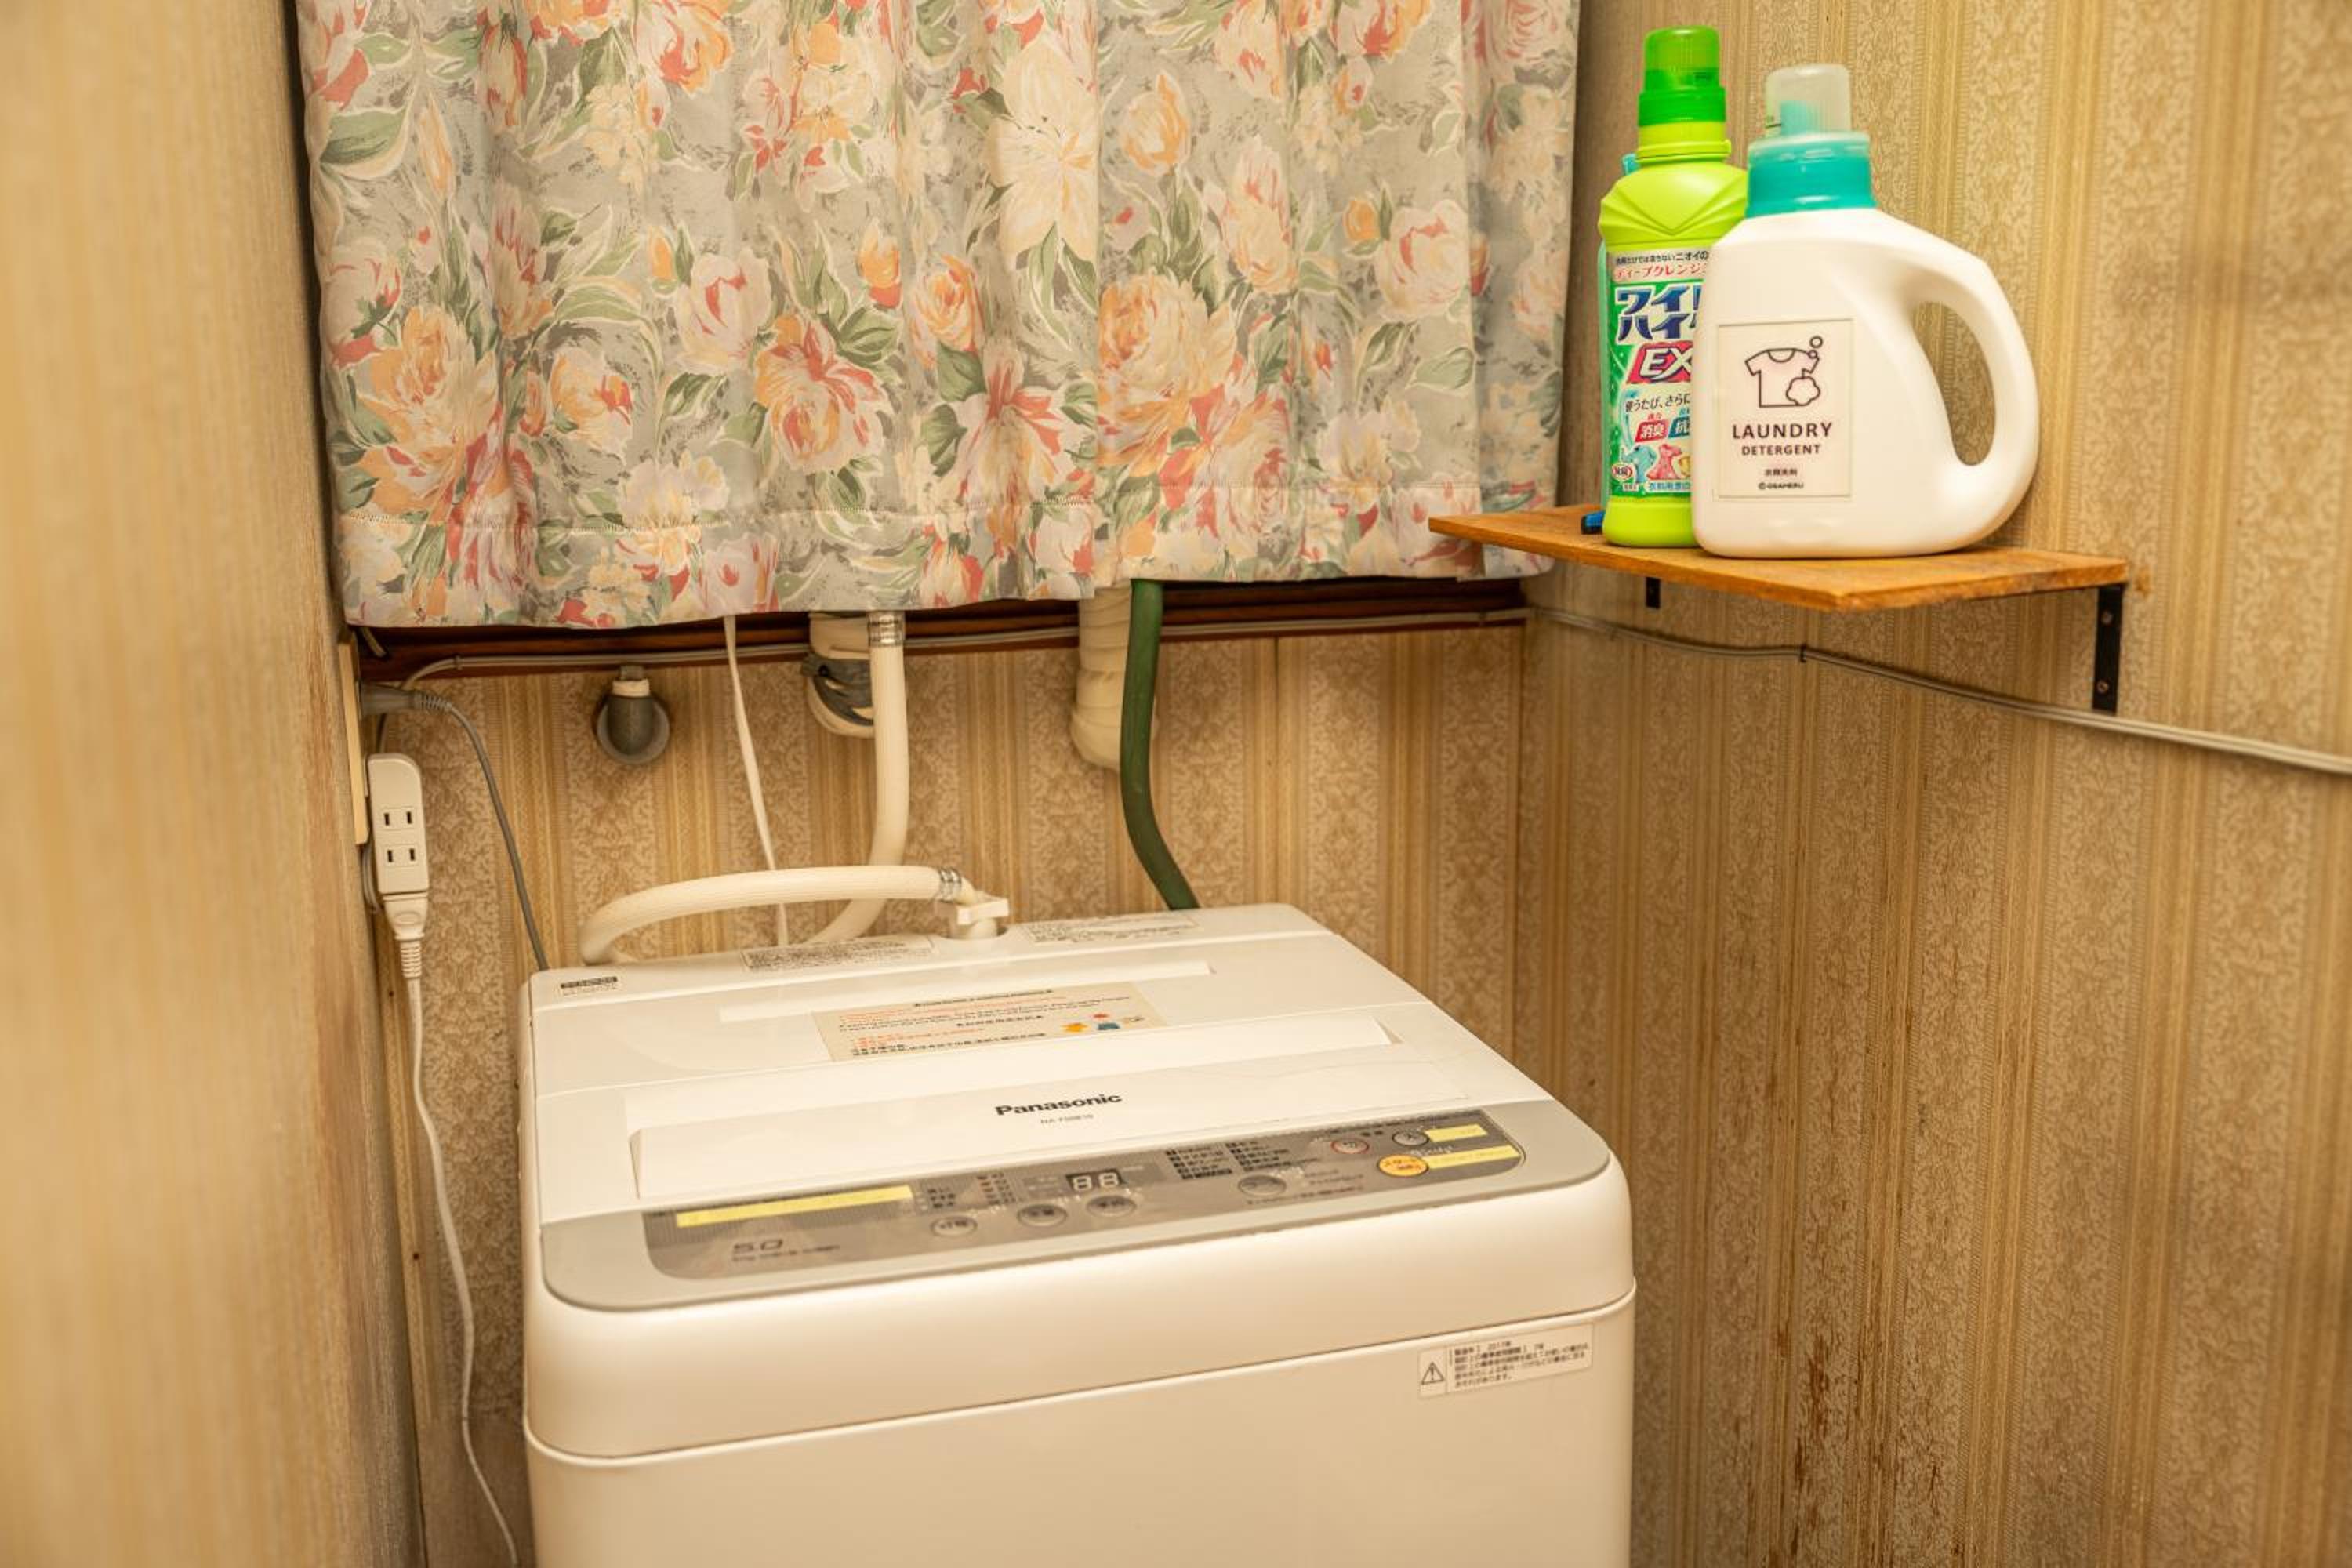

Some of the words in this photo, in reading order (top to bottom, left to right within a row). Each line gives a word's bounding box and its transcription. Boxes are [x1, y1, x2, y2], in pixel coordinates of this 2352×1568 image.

[1639, 347, 1693, 381] EX
[1732, 422, 1832, 439] LAUNDRY
[1741, 444, 1821, 456] DETERGENT
[995, 1094, 1123, 1116] Panasonic
